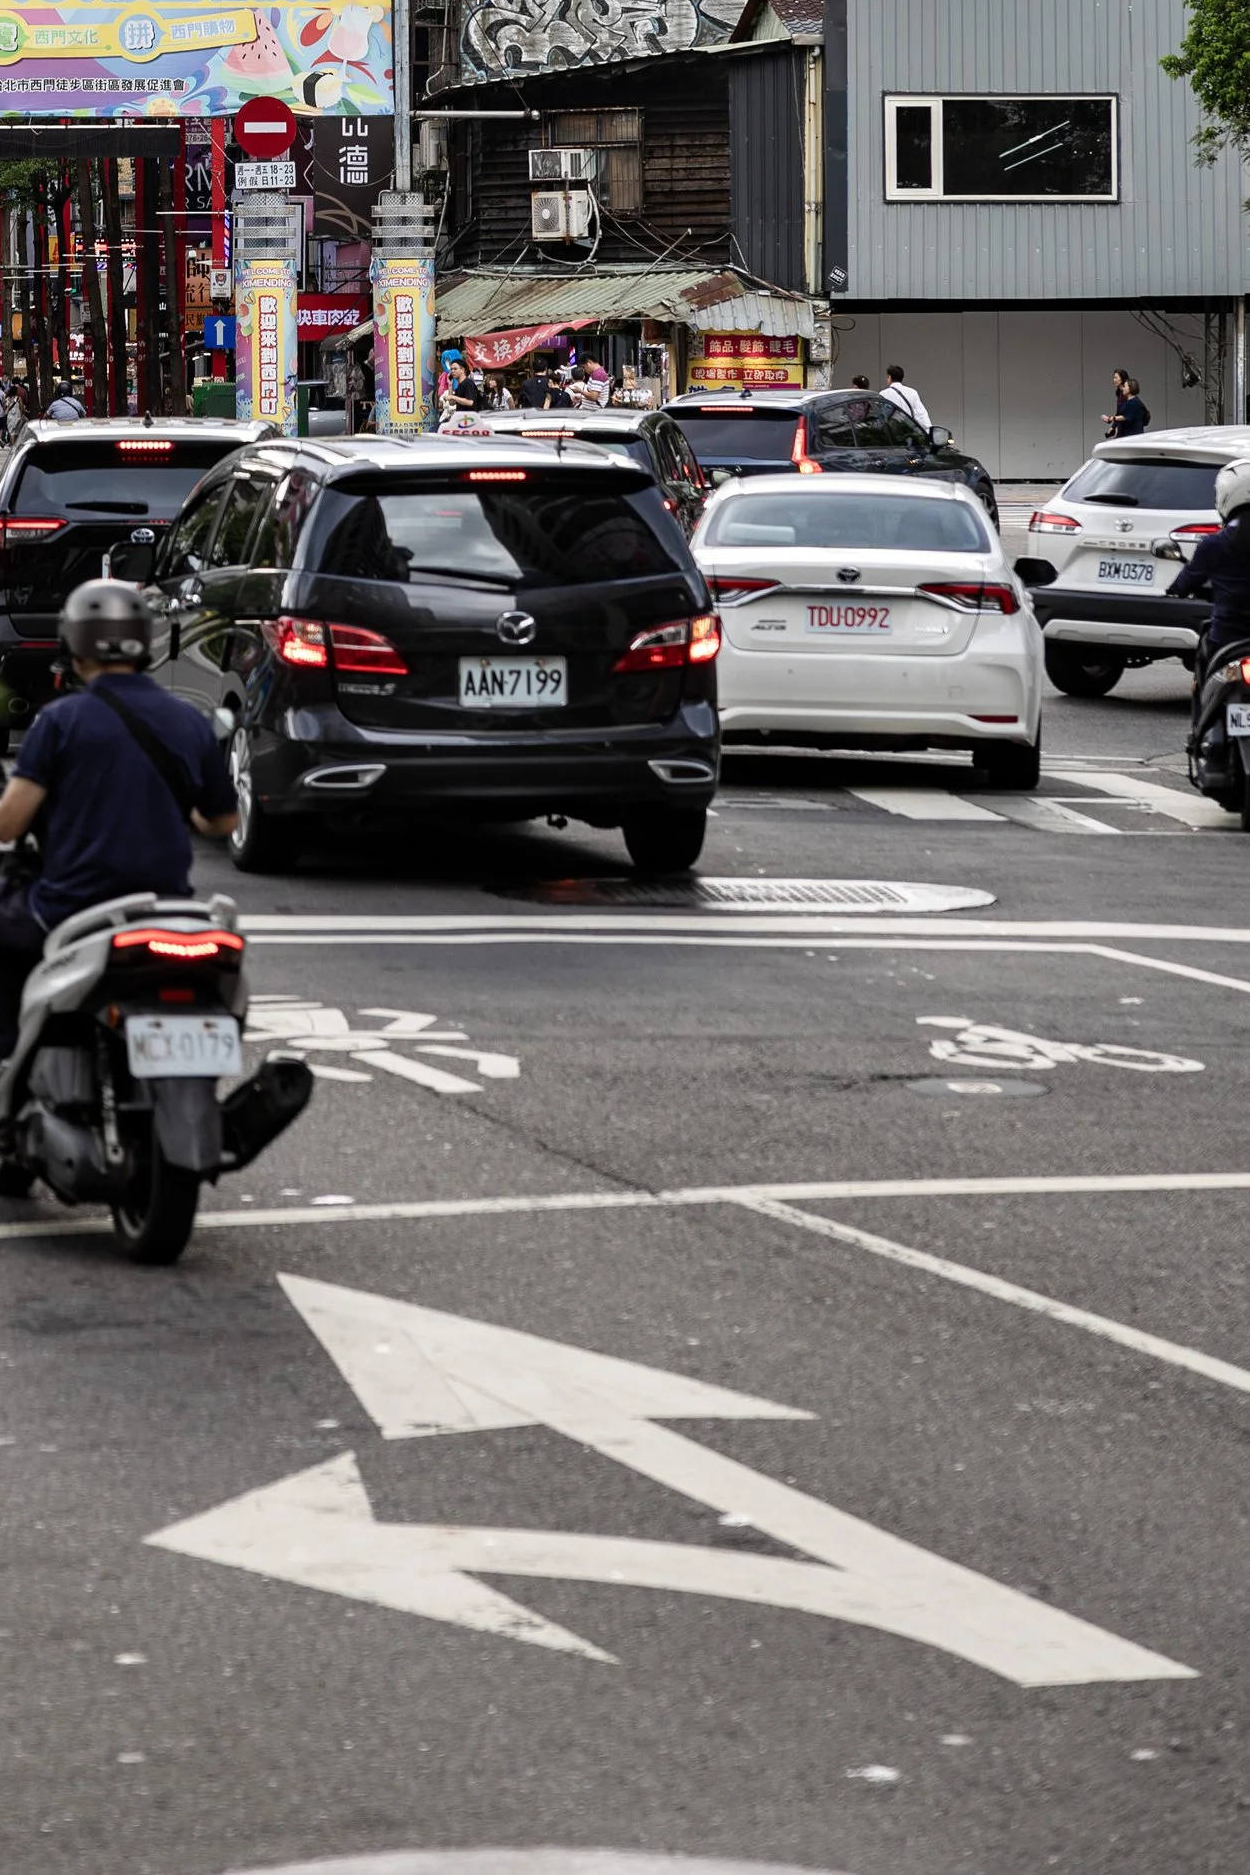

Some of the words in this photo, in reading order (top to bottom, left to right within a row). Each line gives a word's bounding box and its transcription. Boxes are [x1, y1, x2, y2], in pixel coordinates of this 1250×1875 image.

[34, 28, 99, 46] 西門文化
[170, 17, 235, 41] 西門購物
[241, 267, 280, 276] WELCOME
[280, 267, 291, 276] TO
[378, 267, 416, 276] WELCOME
[417, 267, 428, 276] TO
[241, 278, 292, 289] XIMENDING
[378, 278, 428, 288] XIMENDING
[297, 308, 361, 326] 快車肉乾
[258, 294, 278, 415] 歡迎來到西門町
[394, 294, 415, 415] 歡迎來到西門町
[743, 369, 786, 381] 立即取件
[806, 605, 890, 629] TDU-0992
[463, 667, 563, 698] AAN-7199
